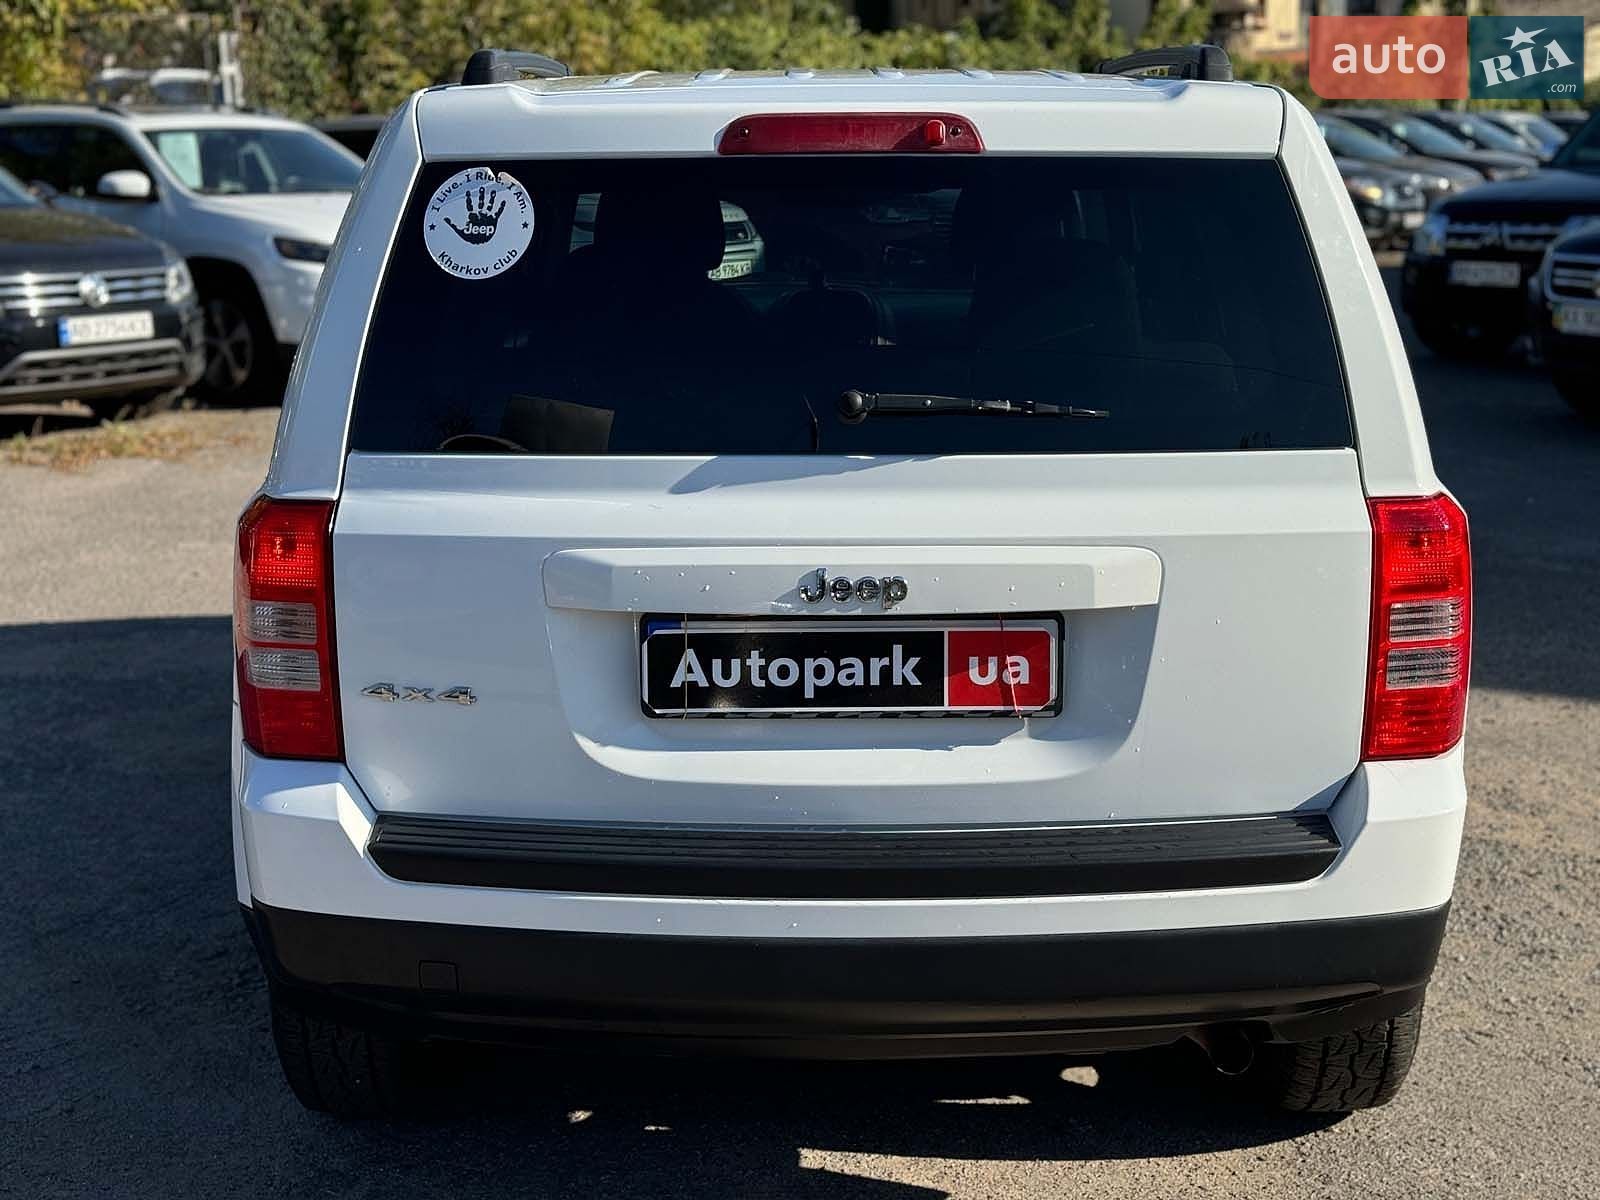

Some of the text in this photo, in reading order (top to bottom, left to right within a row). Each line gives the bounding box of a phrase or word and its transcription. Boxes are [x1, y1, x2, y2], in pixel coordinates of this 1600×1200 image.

[436, 182, 463, 204] Live.
[513, 191, 528, 214] Am.
[463, 223, 495, 236] Jeep
[438, 248, 518, 276] Kharkov club
[798, 567, 909, 609] Jeep
[669, 644, 1031, 699] Autopark ua
[360, 681, 478, 706] 4x4
